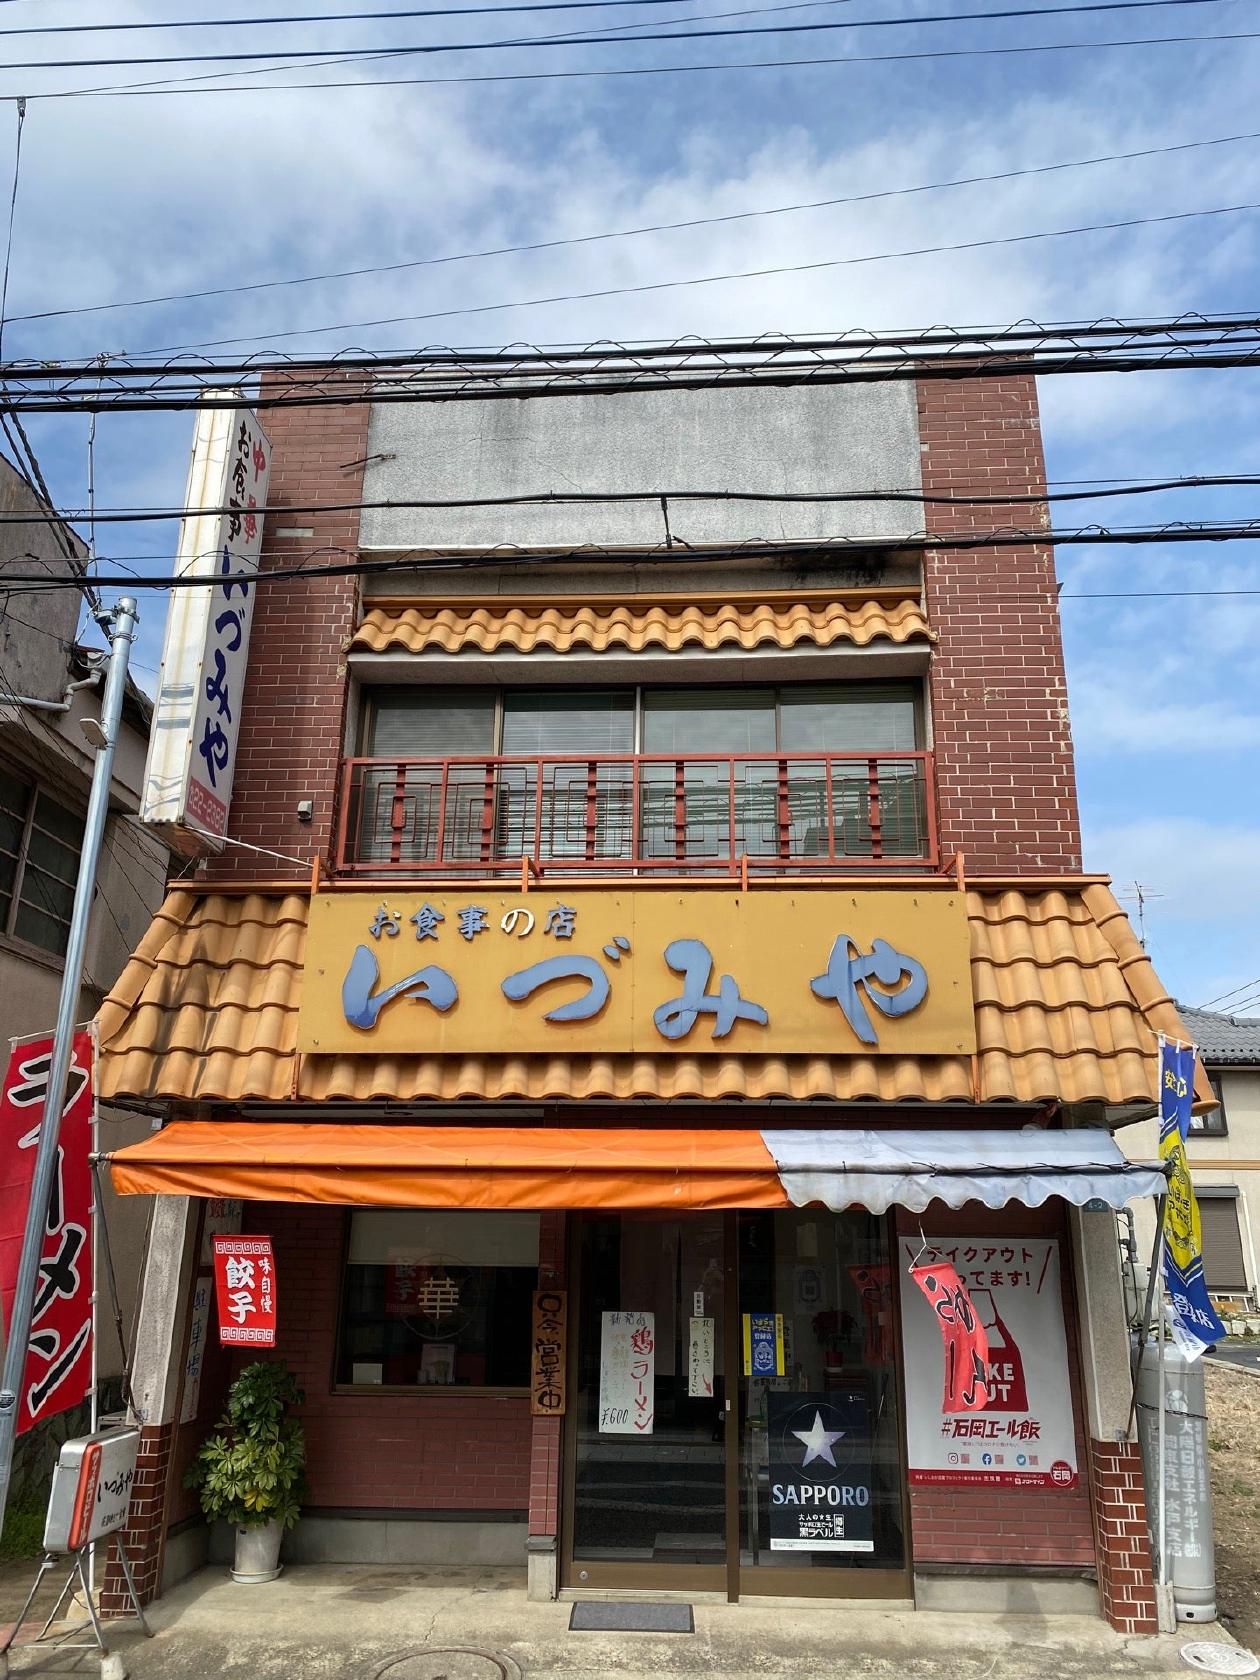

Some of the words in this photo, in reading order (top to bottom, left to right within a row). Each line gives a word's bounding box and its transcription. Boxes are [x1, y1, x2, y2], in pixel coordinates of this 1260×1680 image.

[226, 419, 252, 543] お食事
[199, 545, 249, 788] いづみや
[369, 902, 578, 940] お食事の店
[341, 933, 931, 1046] いづみや
[257, 1256, 273, 1314] 味自慢
[926, 1245, 1034, 1265] テイクアウト
[225, 1255, 257, 1324] 餃子
[535, 1292, 563, 1410] 只今営業中
[630, 1326, 654, 1431] 鶏ラーメン
[941, 1417, 1041, 1440] #石岡エール飯
[772, 1483, 869, 1508] SAPPORO
[799, 1528, 834, 1538] 黒ラベル
